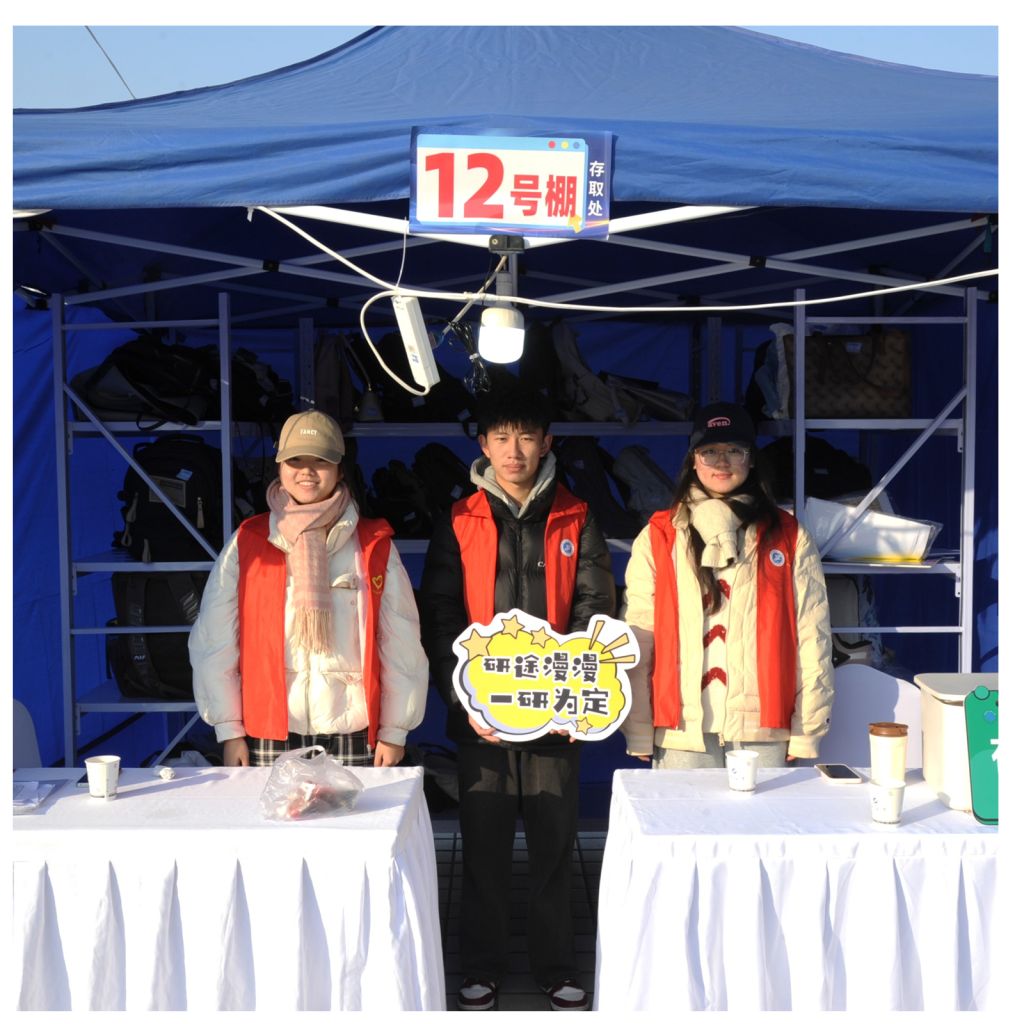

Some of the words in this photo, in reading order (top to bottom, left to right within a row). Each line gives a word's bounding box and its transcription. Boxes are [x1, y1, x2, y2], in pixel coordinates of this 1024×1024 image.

[425, 152, 577, 219] 12号棚
[588, 160, 605, 217] 存取处
[483, 652, 598, 684] 研途漫漫
[490, 687, 609, 715] 一研为定
